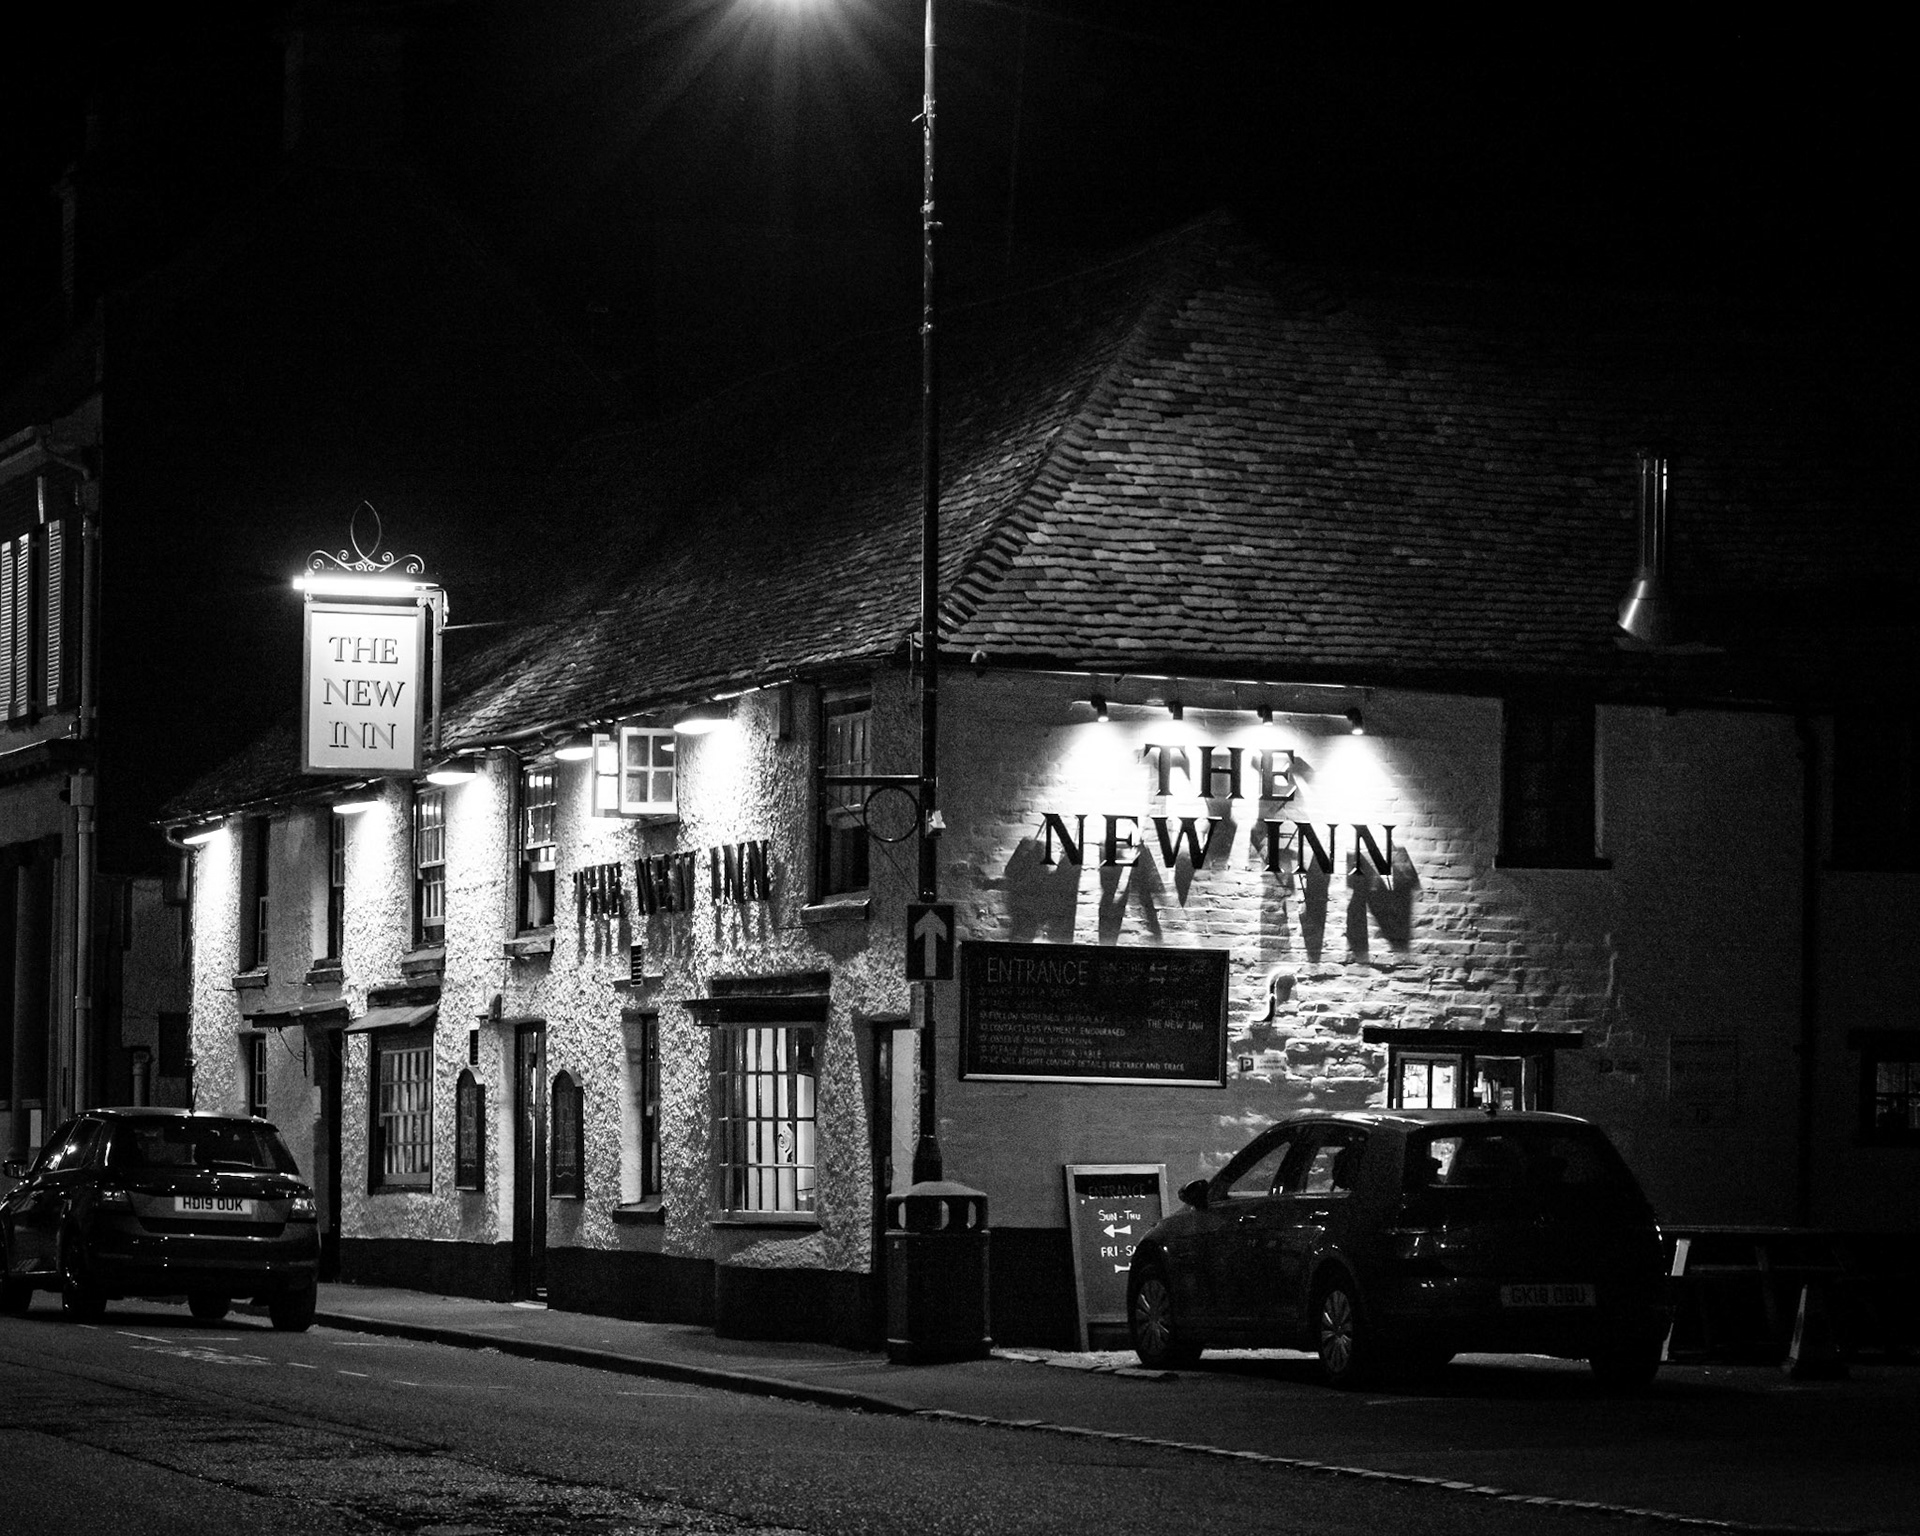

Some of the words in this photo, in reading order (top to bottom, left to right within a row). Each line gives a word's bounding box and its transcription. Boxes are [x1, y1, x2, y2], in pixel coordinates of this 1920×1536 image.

[328, 637, 398, 664] THE
[323, 678, 406, 707] NEW
[329, 721, 397, 750] INN
[1143, 743, 1297, 801] THE
[1040, 812, 1223, 870] NEW
[1264, 818, 1397, 876] INN
[573, 862, 623, 917] THE
[634, 850, 697, 915] NEW
[709, 840, 769, 905] INN
[986, 956, 1089, 986] ENTRANCE
[989, 1022, 1042, 1034] CONTACTLESS
[1079, 1026, 1126, 1037] ENCOURAGED
[1147, 1018, 1162, 1029] THE
[1164, 1019, 1185, 1030] NEW
[1187, 1020, 1204, 1031] INN
[1045, 1057, 1075, 1067] CONTACT
[1108, 1061, 1121, 1070] FOR
[1122, 1061, 1144, 1070] TRACK
[1145, 1062, 1160, 1071] AND
[1163, 1062, 1185, 1072] TRACE
[183, 1196, 213, 1210] HD19
[217, 1198, 243, 1211] OUK
[1087, 1183, 1146, 1200] ENTRANCE
